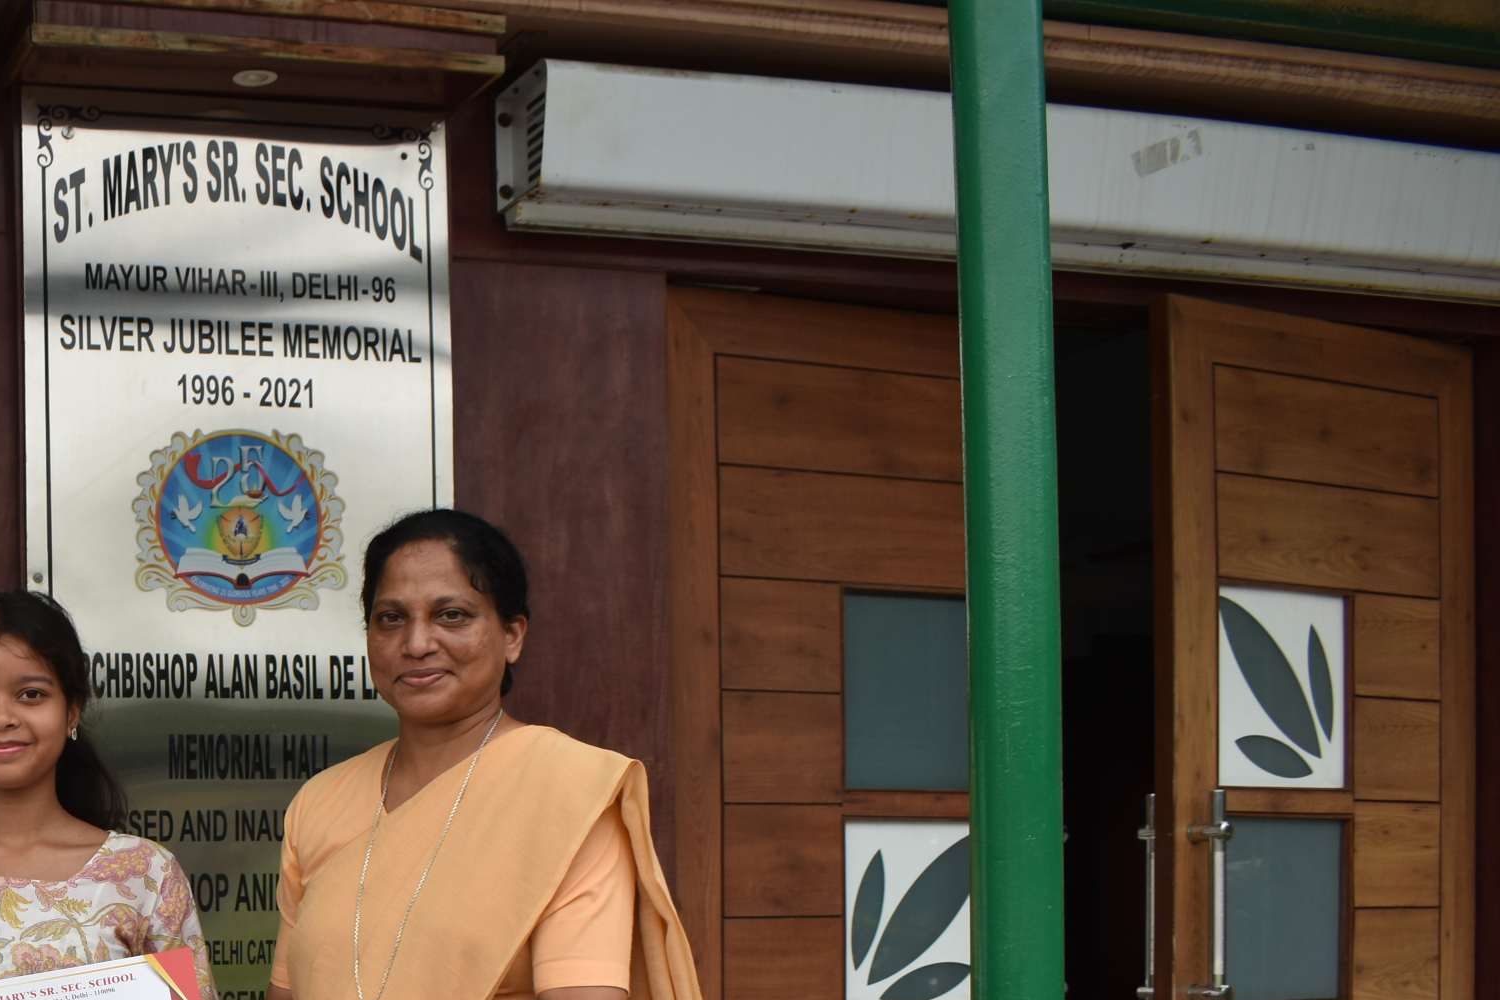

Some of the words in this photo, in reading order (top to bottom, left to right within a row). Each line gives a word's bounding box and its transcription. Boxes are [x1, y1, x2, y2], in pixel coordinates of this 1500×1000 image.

[53, 167, 93, 243] ST.
[102, 140, 198, 221] MARY'S
[206, 139, 246, 203] SR.
[255, 142, 310, 213] SEC.
[320, 156, 422, 264] SCHOOL
[85, 263, 168, 292] MAYUR
[292, 272, 396, 303] DELHI-96
[60, 314, 155, 352] SILVER
[164, 318, 274, 357] JUBILEE
[283, 323, 422, 363] MEMORIAL
[177, 374, 235, 405] 1996
[259, 376, 314, 409] 2021
[204, 653, 259, 699] ALAN
[265, 653, 324, 699] BASIL
[330, 655, 355, 699] DE
[361, 655, 378, 700] L
[168, 734, 276, 780] MEMORIAL
[283, 734, 328, 780] HALL
[118, 810, 174, 842] SED
[180, 810, 227, 842] AND
[190, 873, 229, 912] OP
[234, 873, 280, 912] ANI
[247, 940, 277, 965] CAT
[40, 986, 58, 997] SR.
[60, 982, 86, 994] SEC.
[88, 973, 137, 988] SCHOOL
[71, 991, 88, 1000] Delhi
